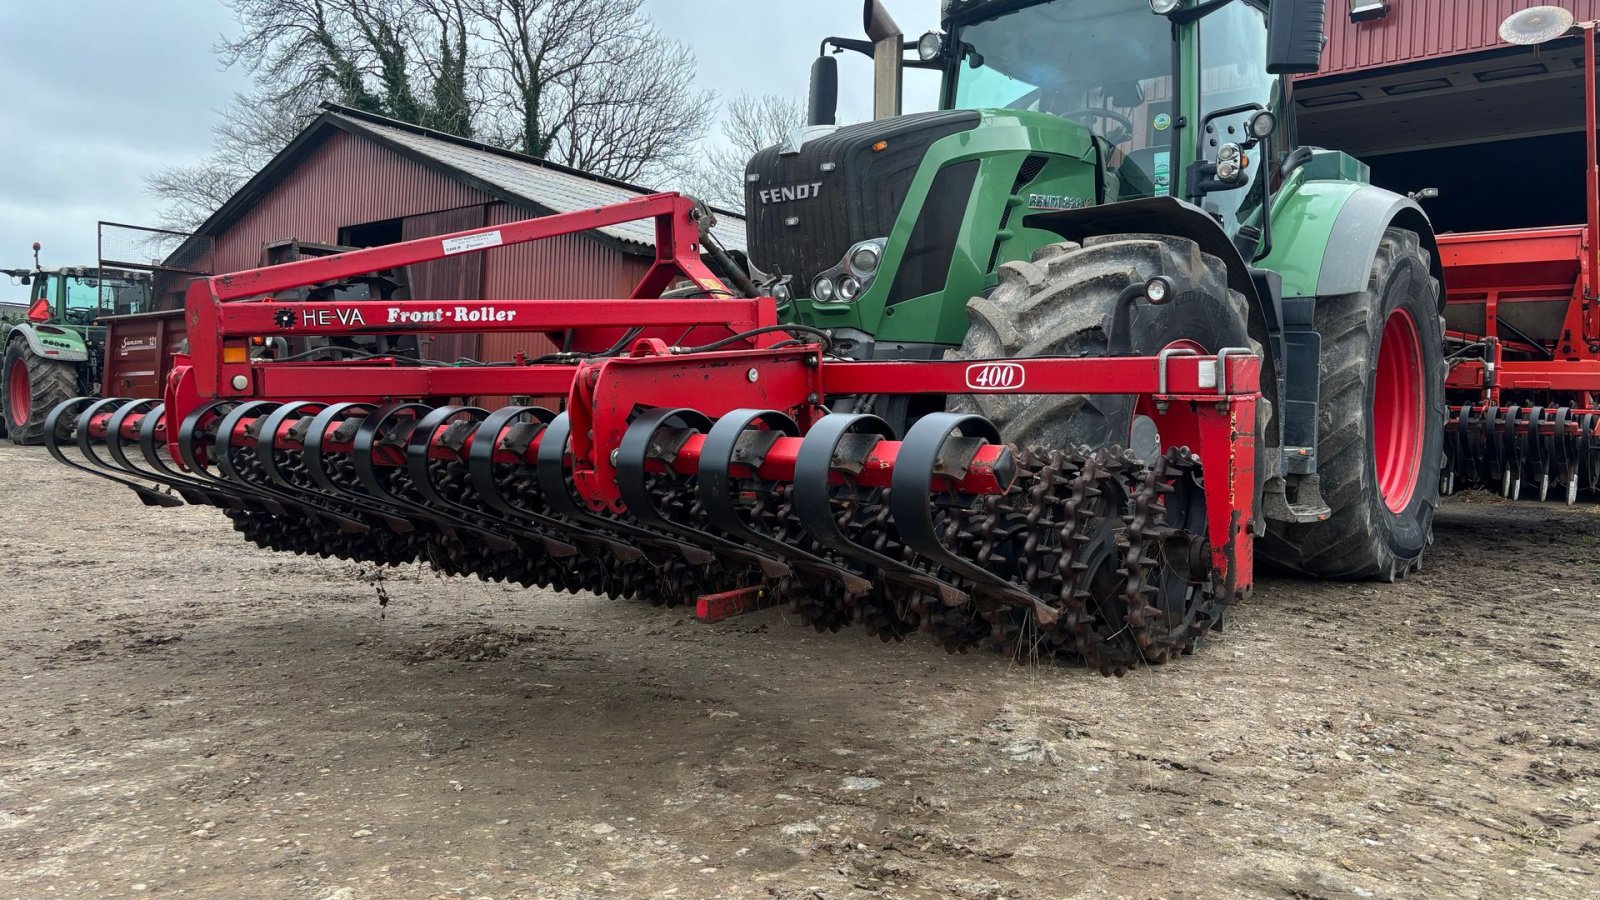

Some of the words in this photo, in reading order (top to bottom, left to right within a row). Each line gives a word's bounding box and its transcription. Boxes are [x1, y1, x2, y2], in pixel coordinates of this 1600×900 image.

[760, 182, 822, 204] FENDT
[302, 308, 366, 327] HE-VA
[386, 306, 517, 323] Front-Roller
[975, 365, 1014, 387] 400
